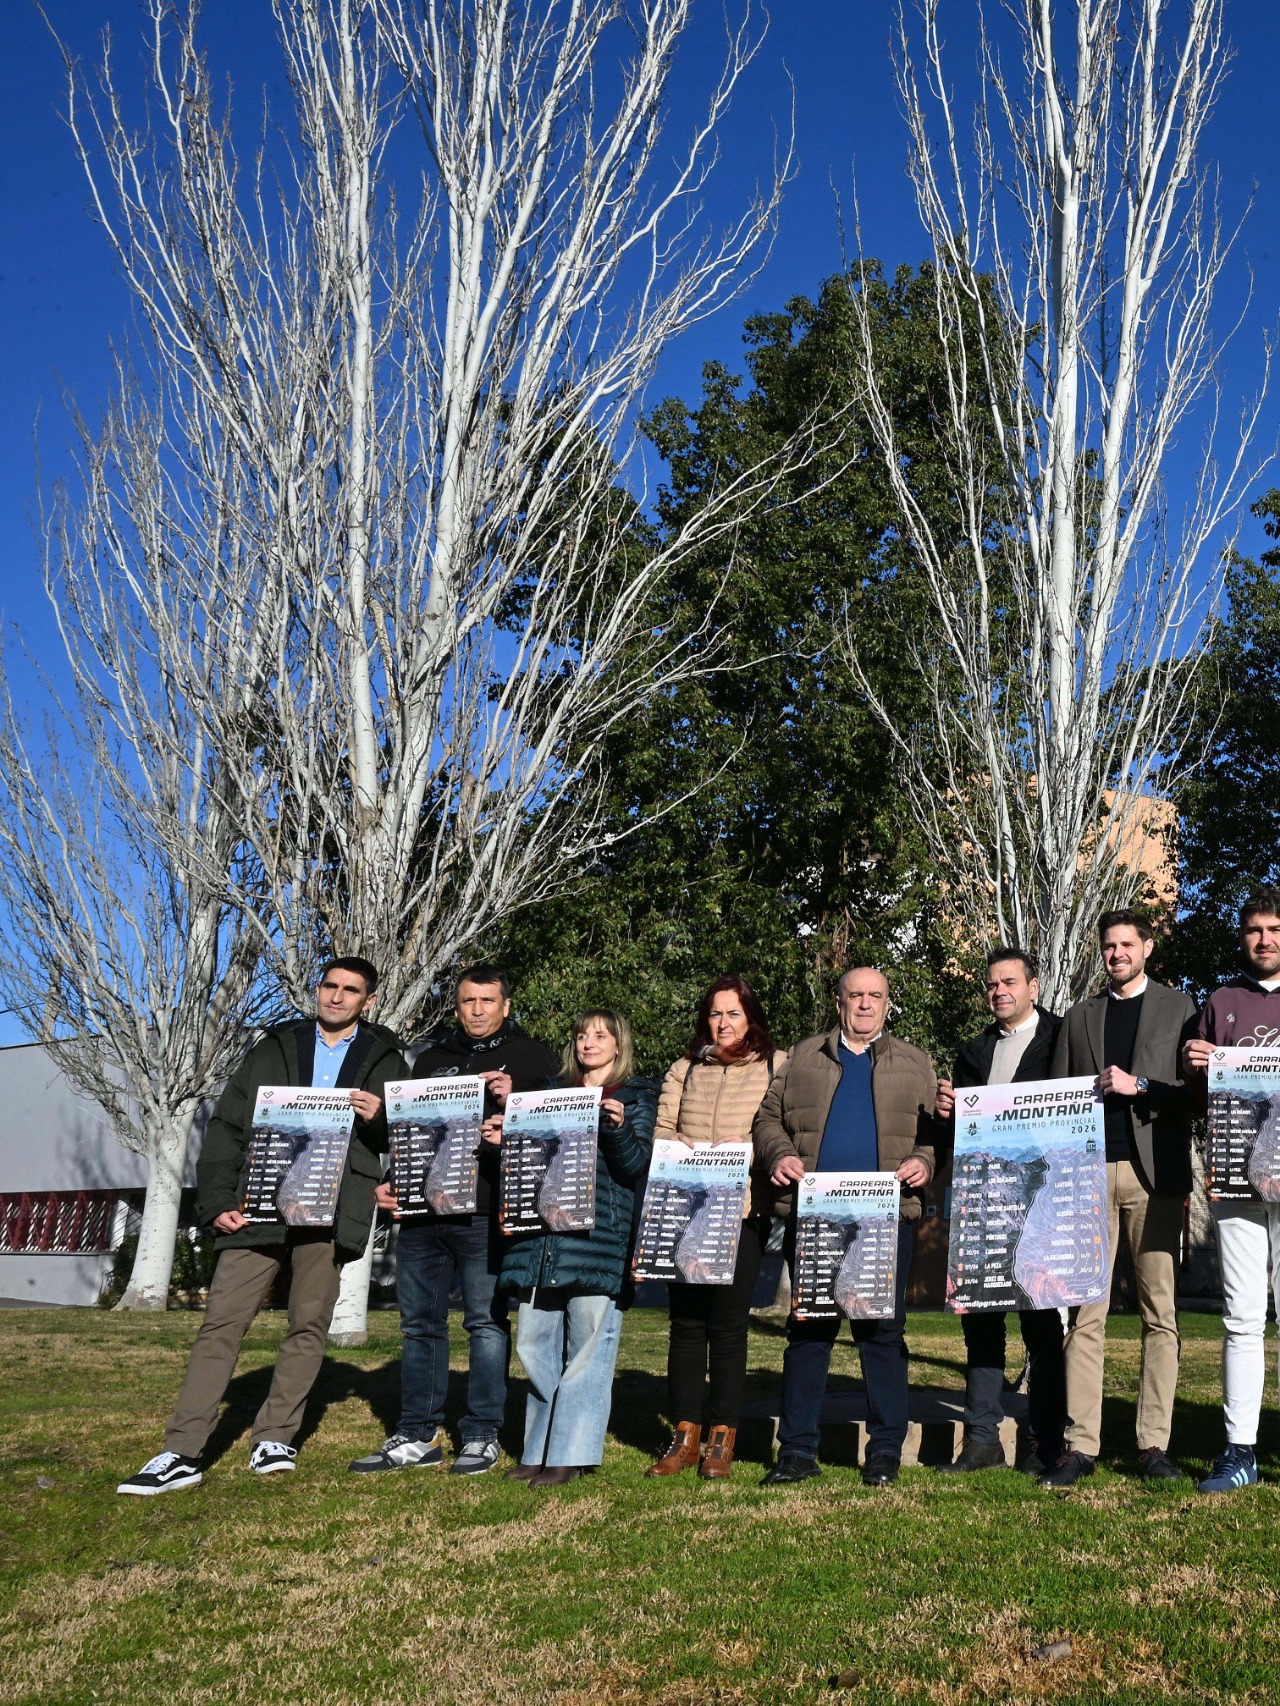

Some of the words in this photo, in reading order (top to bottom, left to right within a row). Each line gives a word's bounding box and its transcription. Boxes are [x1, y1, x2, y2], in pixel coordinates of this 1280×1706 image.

[426, 1082, 480, 1092] CARRERAS
[295, 1094, 353, 1103] CARRERAS
[542, 1094, 595, 1104] CARRERAS
[1013, 1089, 1093, 1106] CARRERAS
[992, 1124, 1012, 1133] GRAN
[1016, 1121, 1046, 1131] PREMIO
[1050, 1116, 1097, 1128] PROVINCIAL
[1071, 1124, 1097, 1135] 2026
